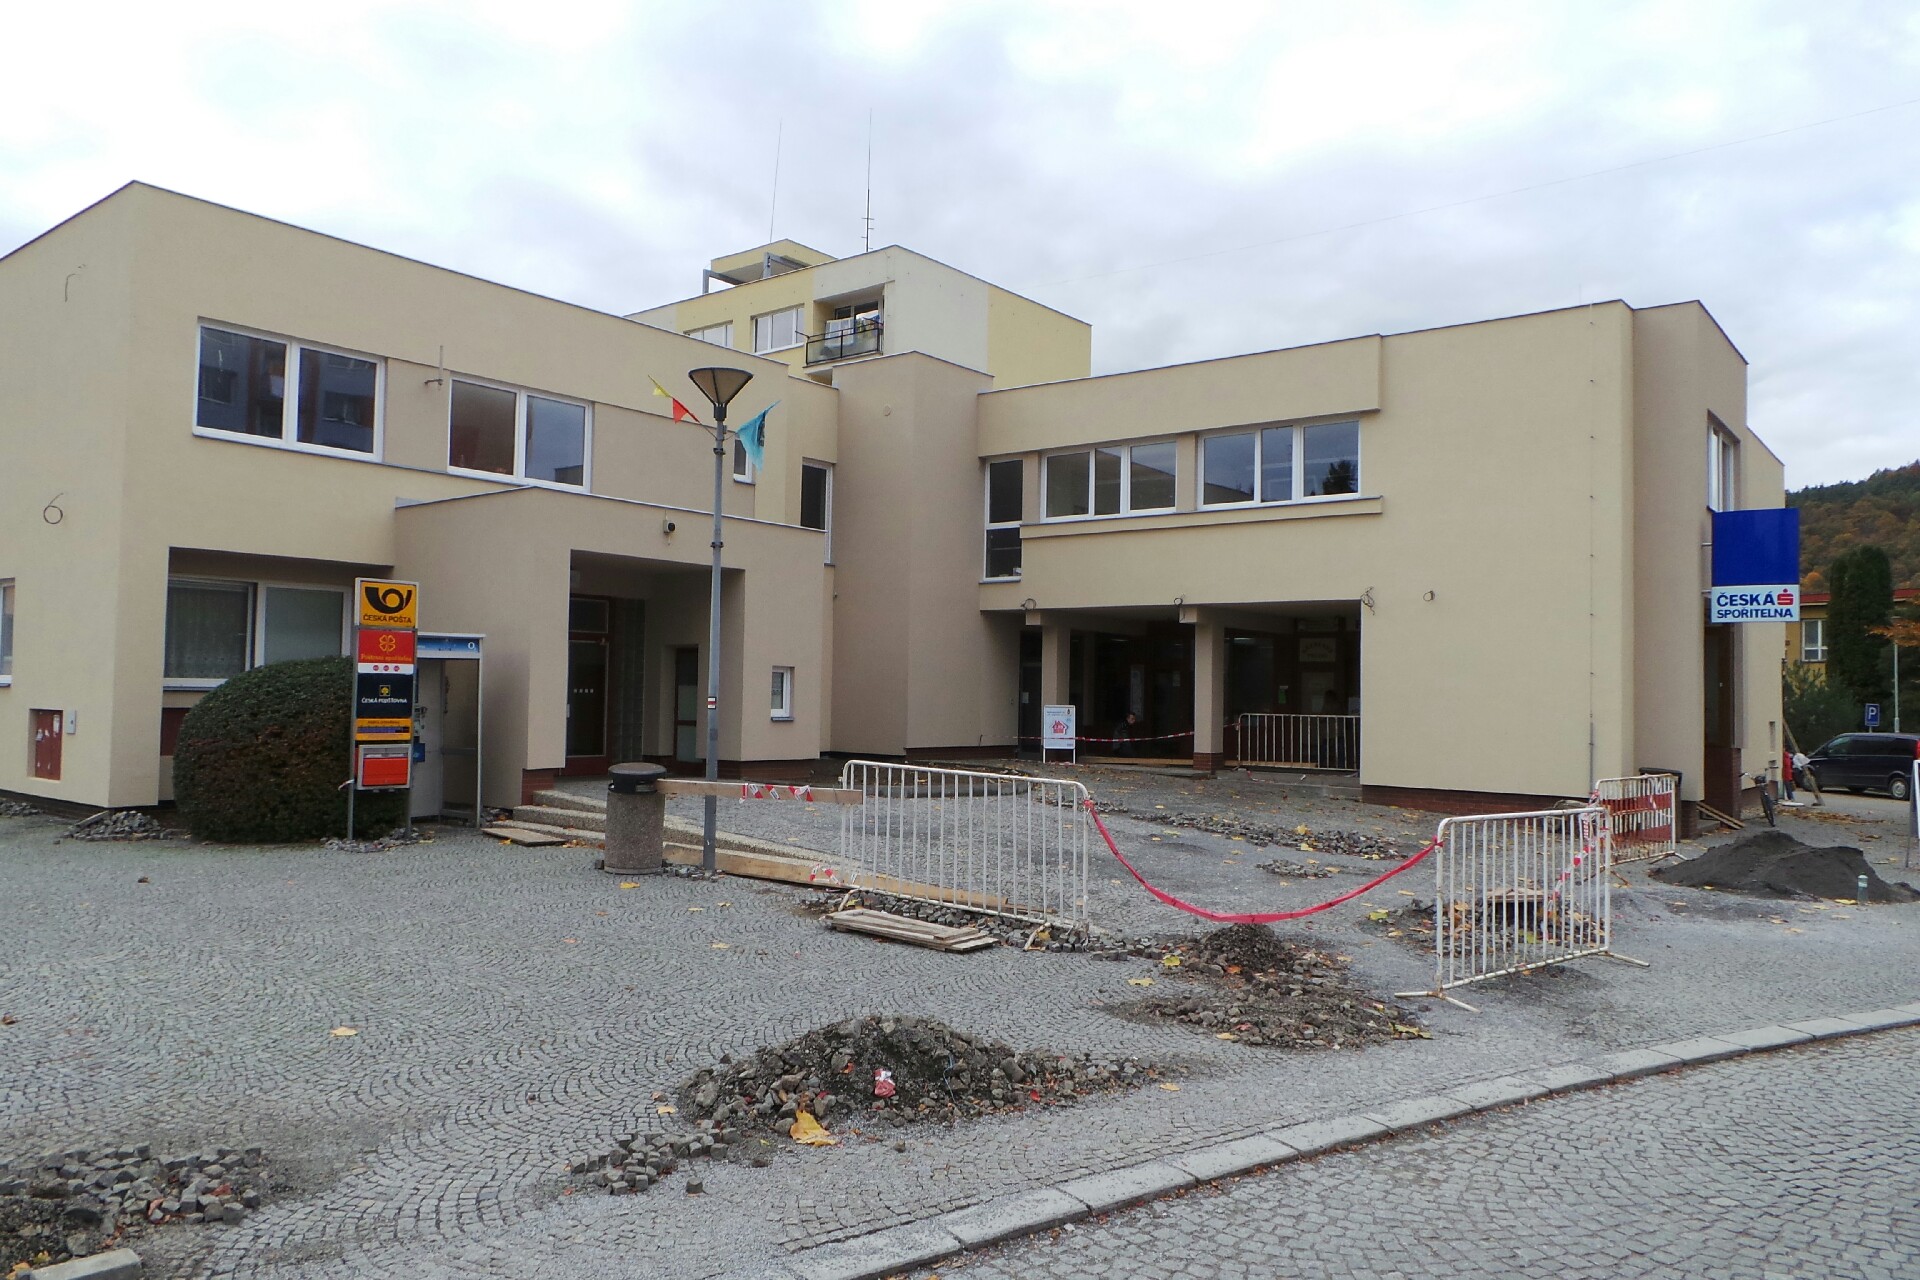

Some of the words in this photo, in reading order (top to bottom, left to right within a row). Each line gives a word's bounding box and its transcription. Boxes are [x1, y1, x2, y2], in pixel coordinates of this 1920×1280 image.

[1717, 591, 1775, 607] ČESKÁ
[363, 614, 387, 622] ČESKÁ
[388, 615, 412, 623] POŠTA
[1717, 607, 1793, 619] SPOŘITELNA
[1868, 707, 1877, 720] P
